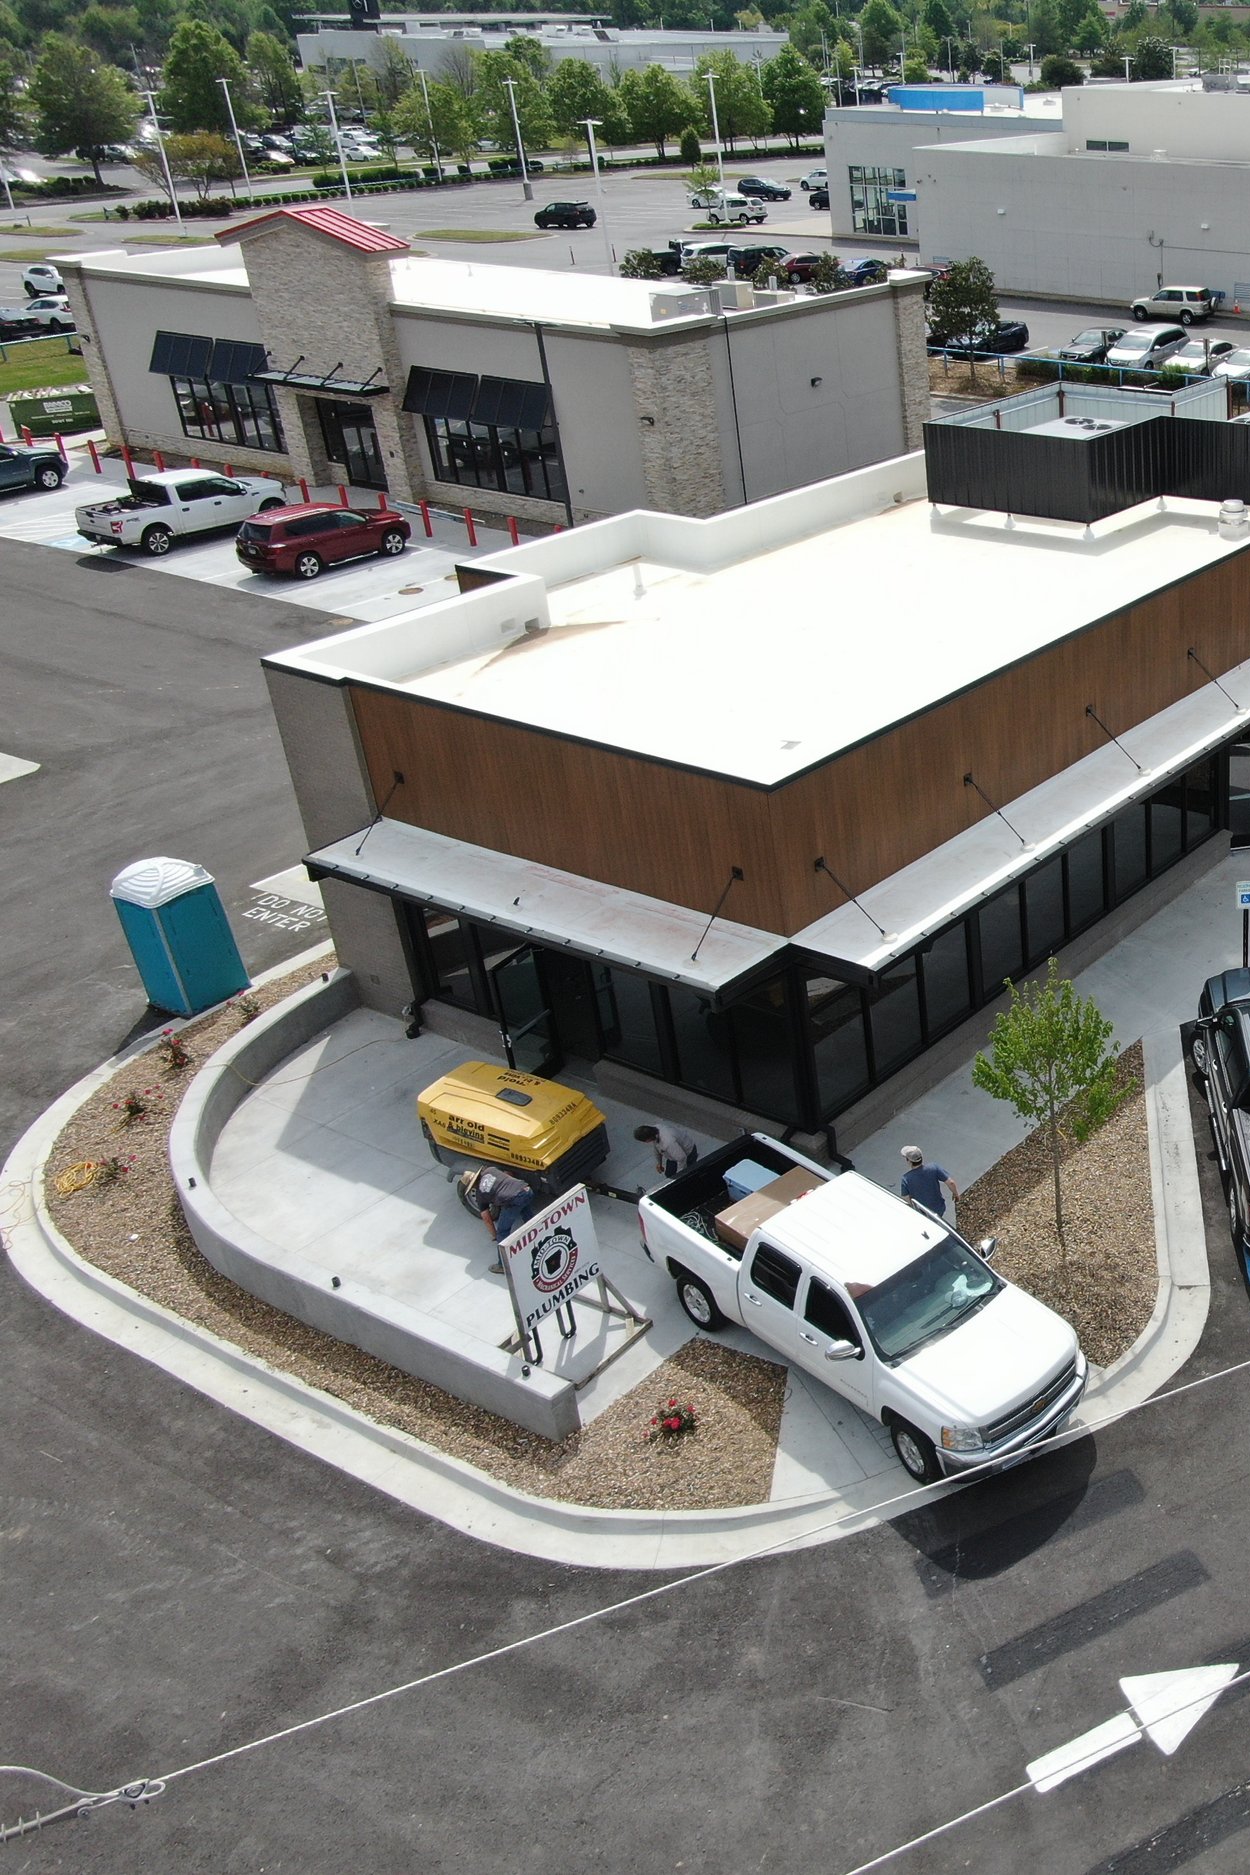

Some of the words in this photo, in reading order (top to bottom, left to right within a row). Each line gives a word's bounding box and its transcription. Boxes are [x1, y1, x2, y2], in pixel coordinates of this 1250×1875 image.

[241, 907, 311, 932] ENTER
[257, 895, 290, 909] DO
[291, 905, 328, 922] NOT
[510, 1192, 586, 1259] MID-TOWN
[534, 1235, 570, 1269] MID-TOWN
[526, 1262, 600, 1328] PLUMBING
